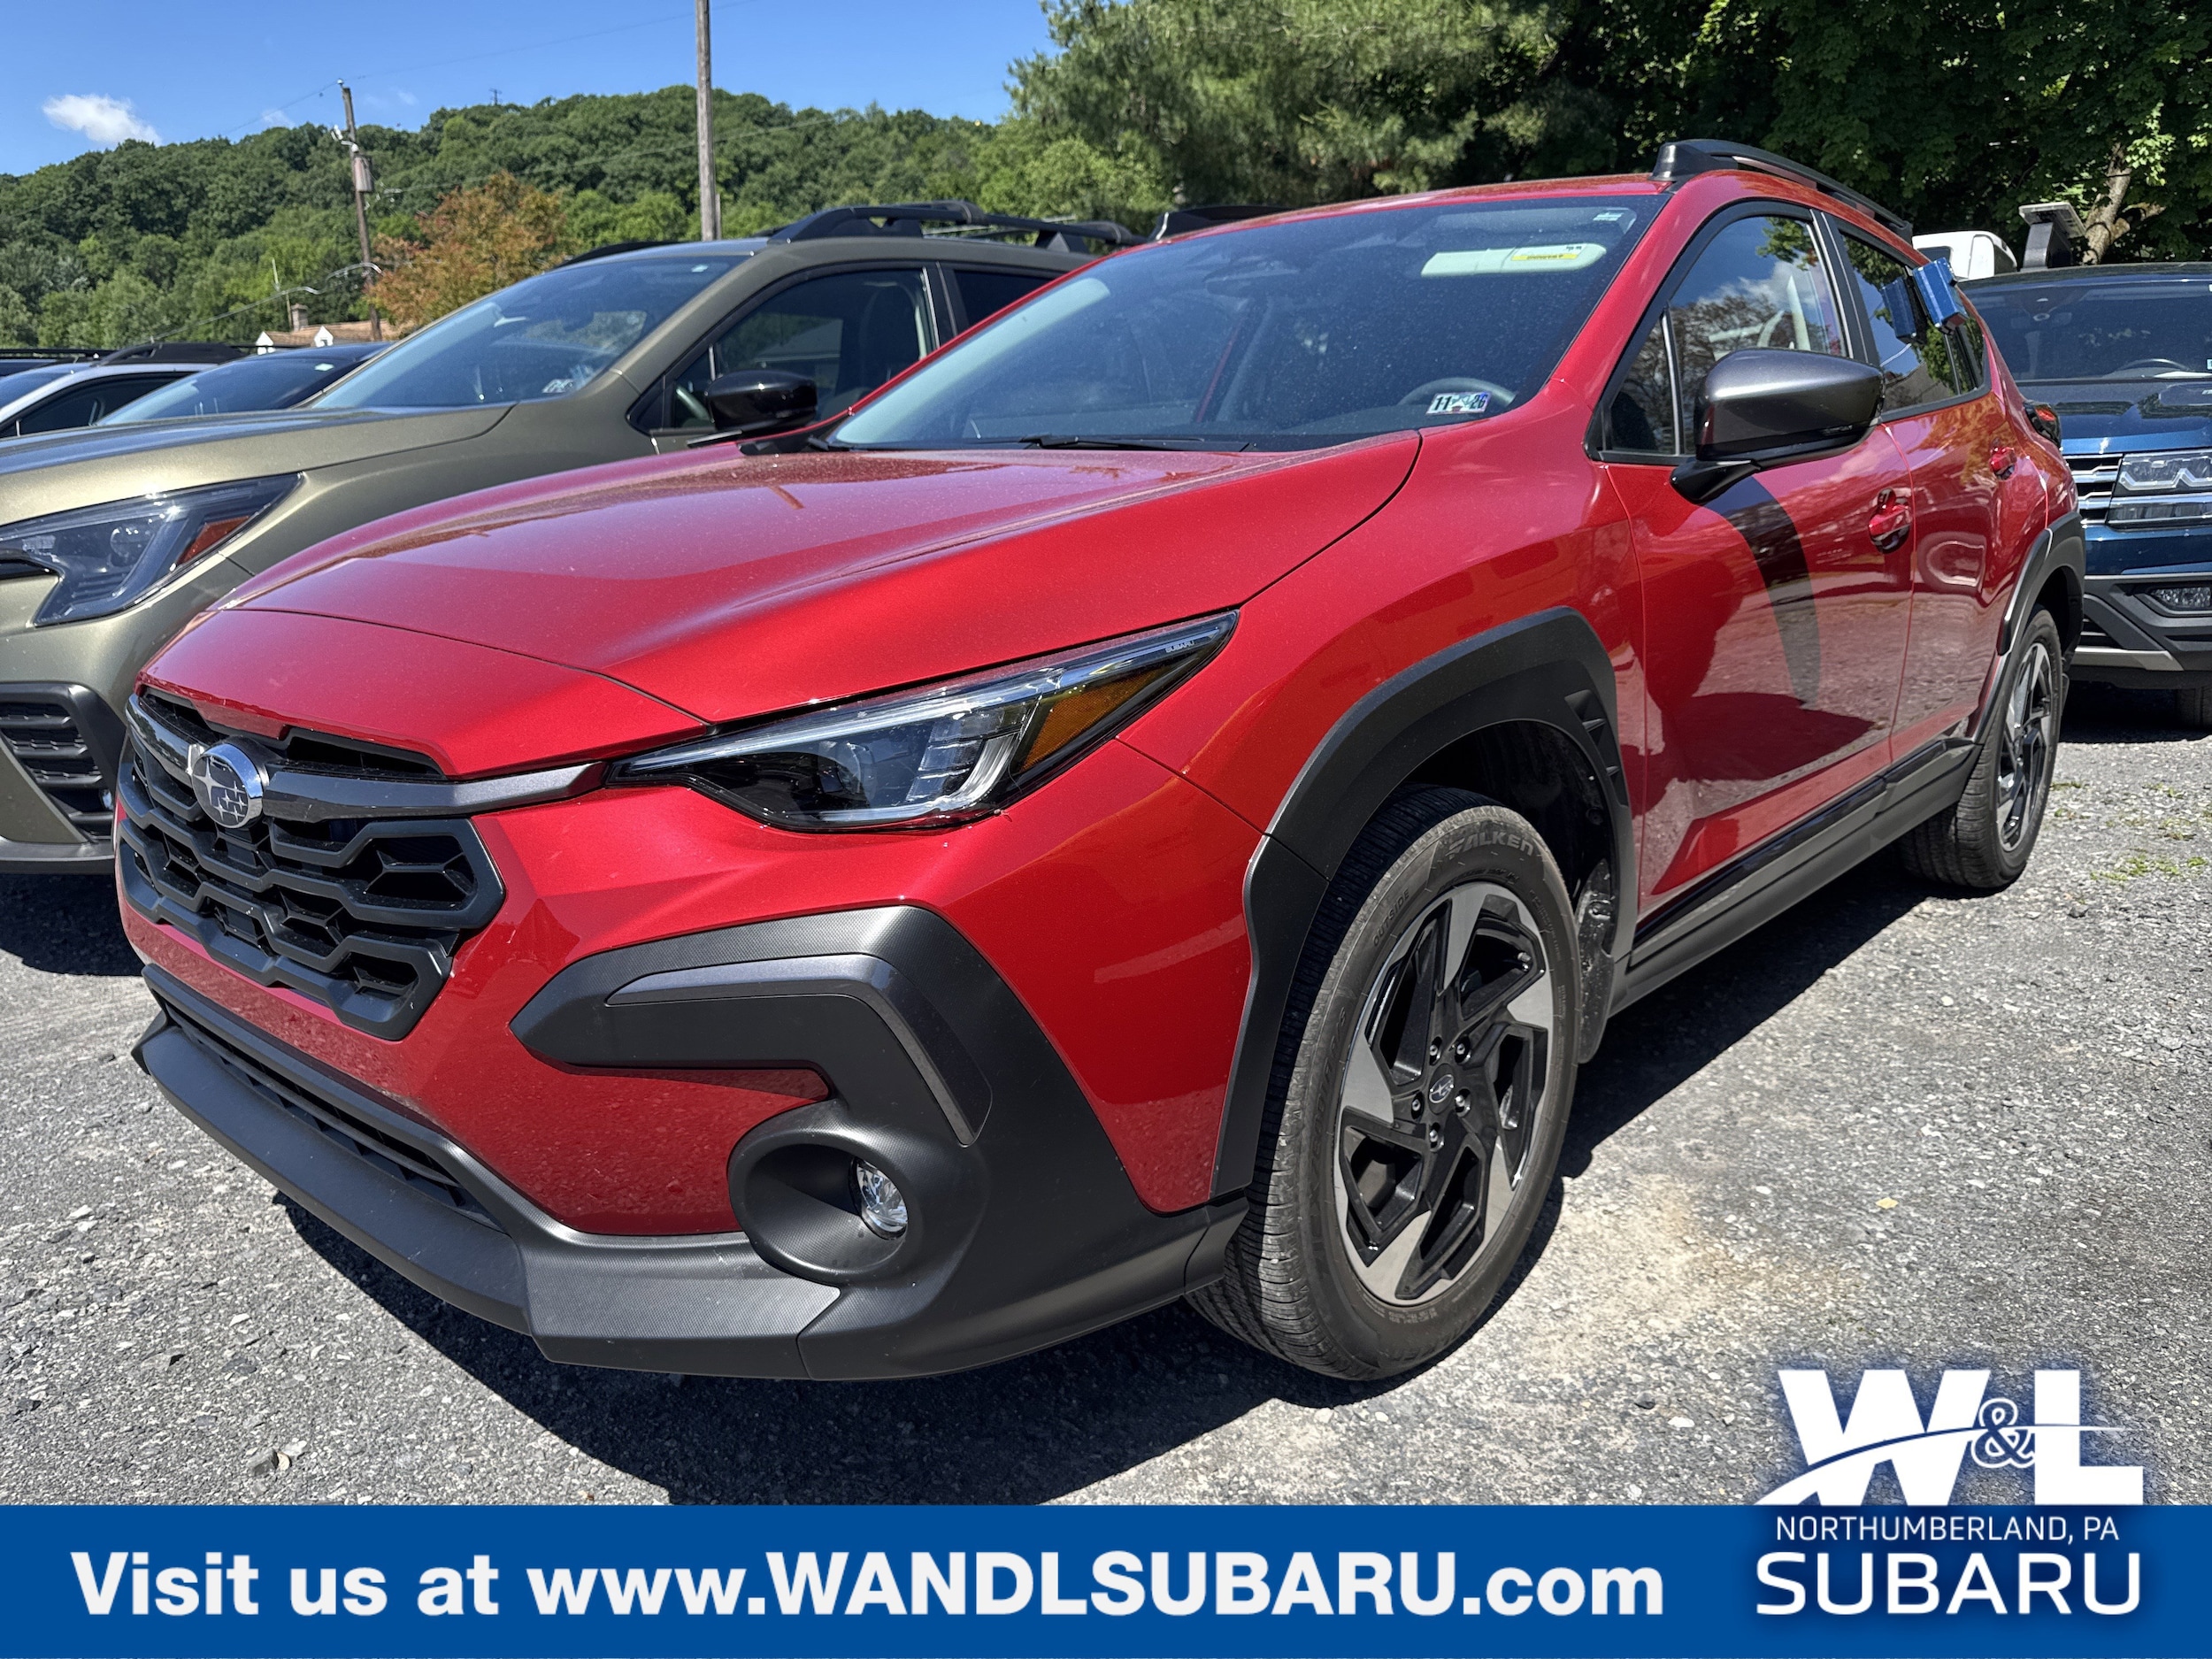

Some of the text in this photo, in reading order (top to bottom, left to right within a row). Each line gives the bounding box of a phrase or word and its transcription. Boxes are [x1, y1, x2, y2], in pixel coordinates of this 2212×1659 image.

[1433, 396, 1452, 411] 11
[1165, 640, 1195, 653] SUBARU
[1445, 831, 1534, 860] FALKEN
[1372, 887, 1410, 948] OUTSIDE
